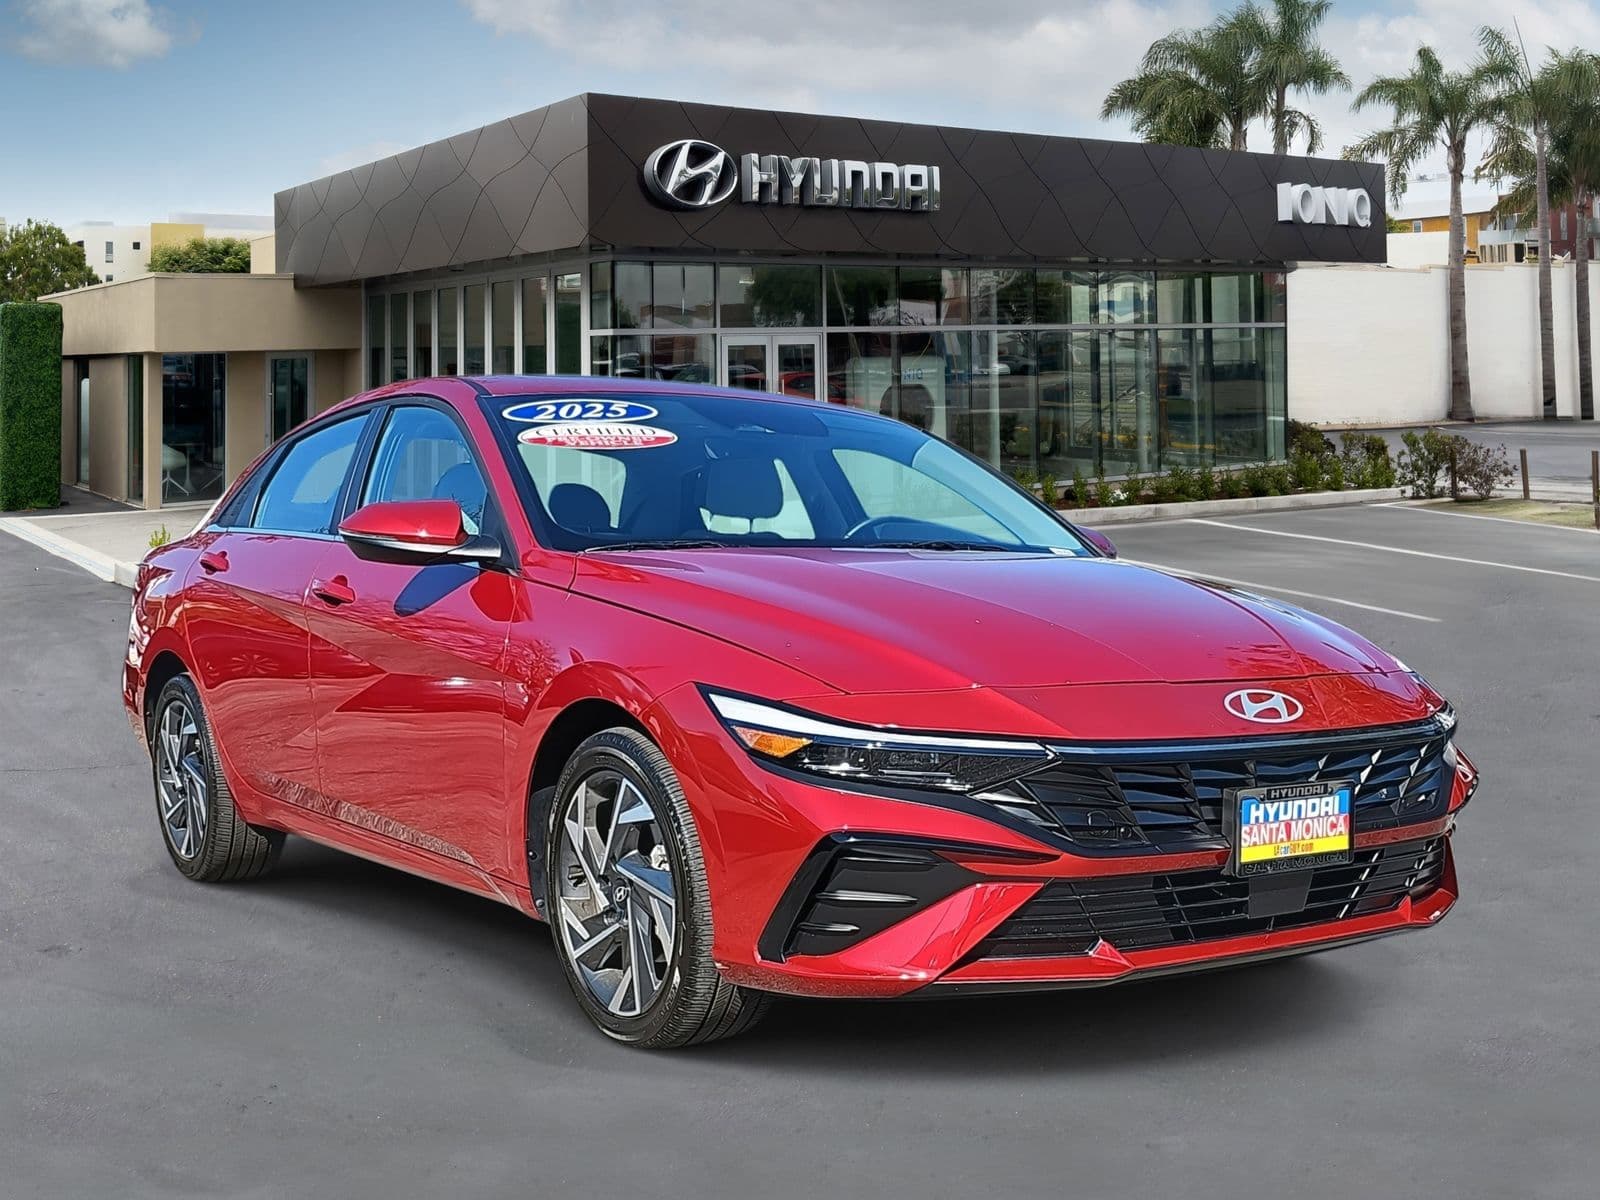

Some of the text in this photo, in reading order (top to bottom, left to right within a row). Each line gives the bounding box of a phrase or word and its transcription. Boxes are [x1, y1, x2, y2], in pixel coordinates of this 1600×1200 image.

[741, 151, 941, 213] HYUNDAI
[1277, 182, 1372, 228] IONIQ
[533, 403, 629, 420] 2025
[1271, 786, 1325, 798] HYUNDAI
[1251, 797, 1340, 824] HYUNDAI
[1242, 815, 1345, 848] SANTA MONICA
